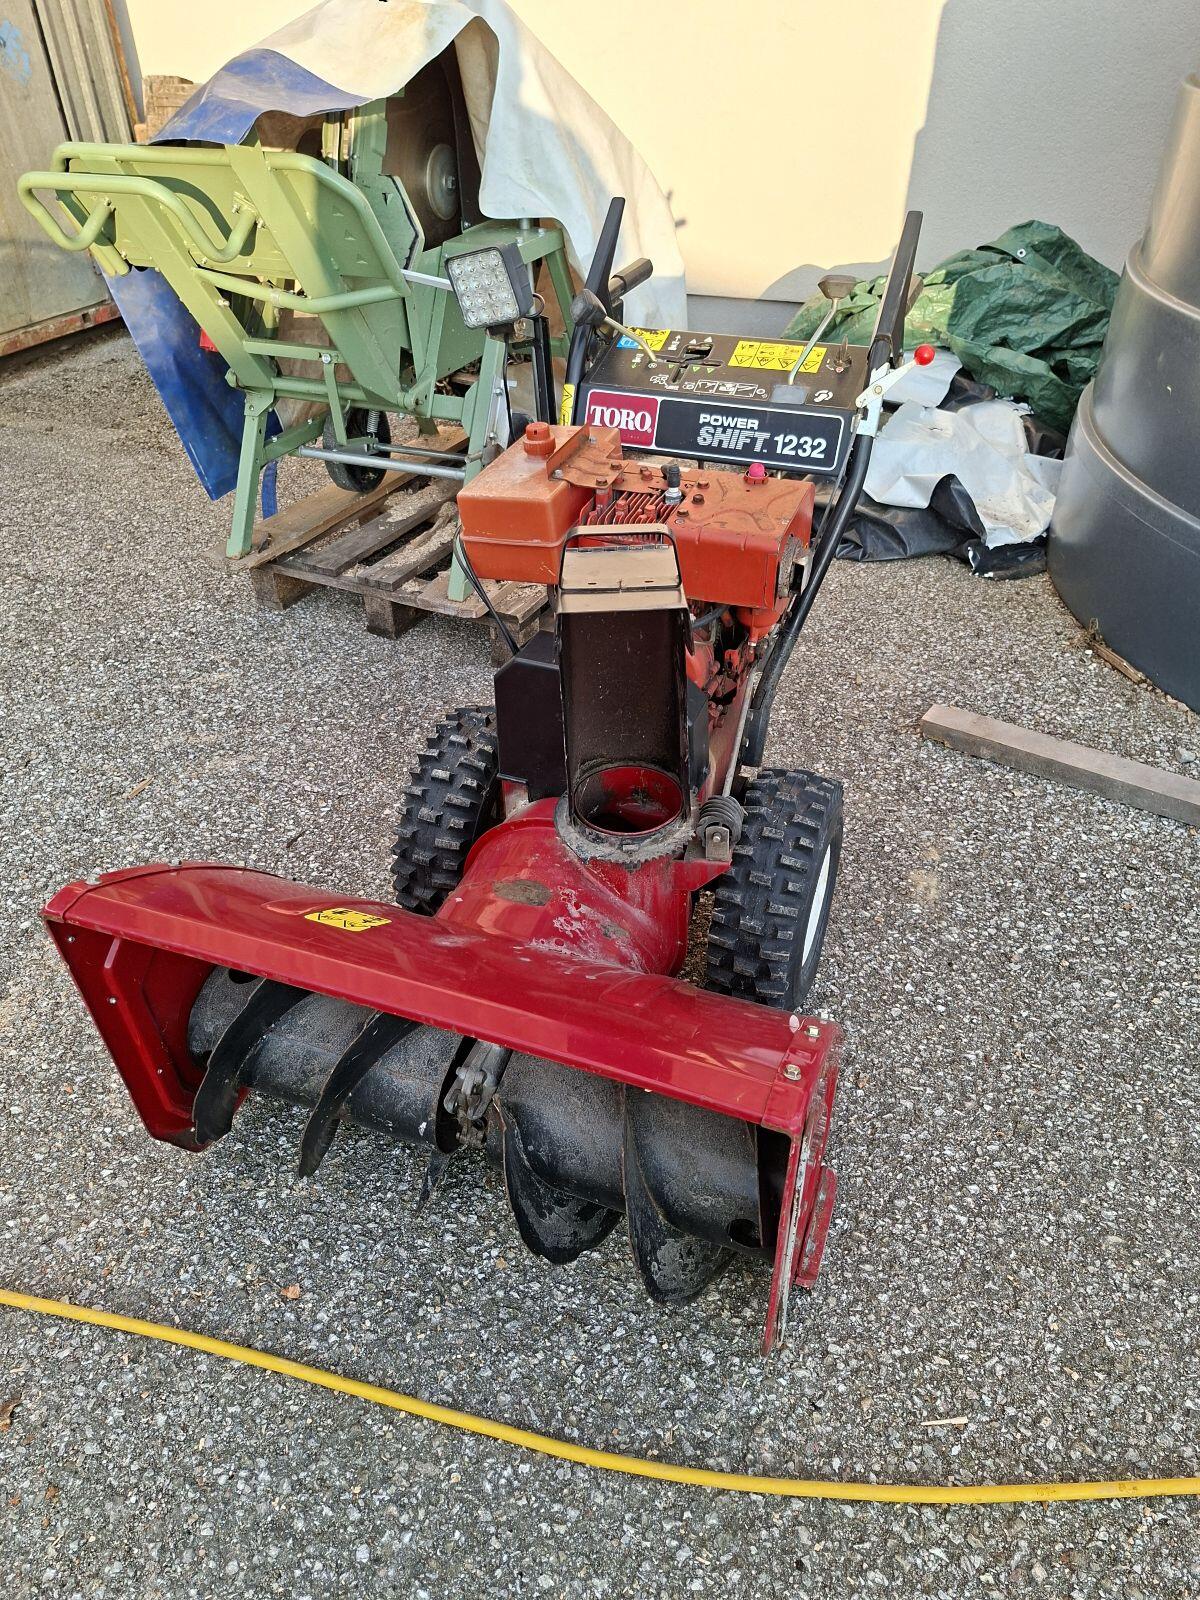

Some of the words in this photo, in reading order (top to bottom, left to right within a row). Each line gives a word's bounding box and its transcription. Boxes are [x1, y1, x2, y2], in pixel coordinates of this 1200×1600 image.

[590, 405, 652, 432] TORO
[699, 413, 759, 431] POWER
[697, 426, 771, 453] SHIFT
[773, 433, 827, 459] 1232
